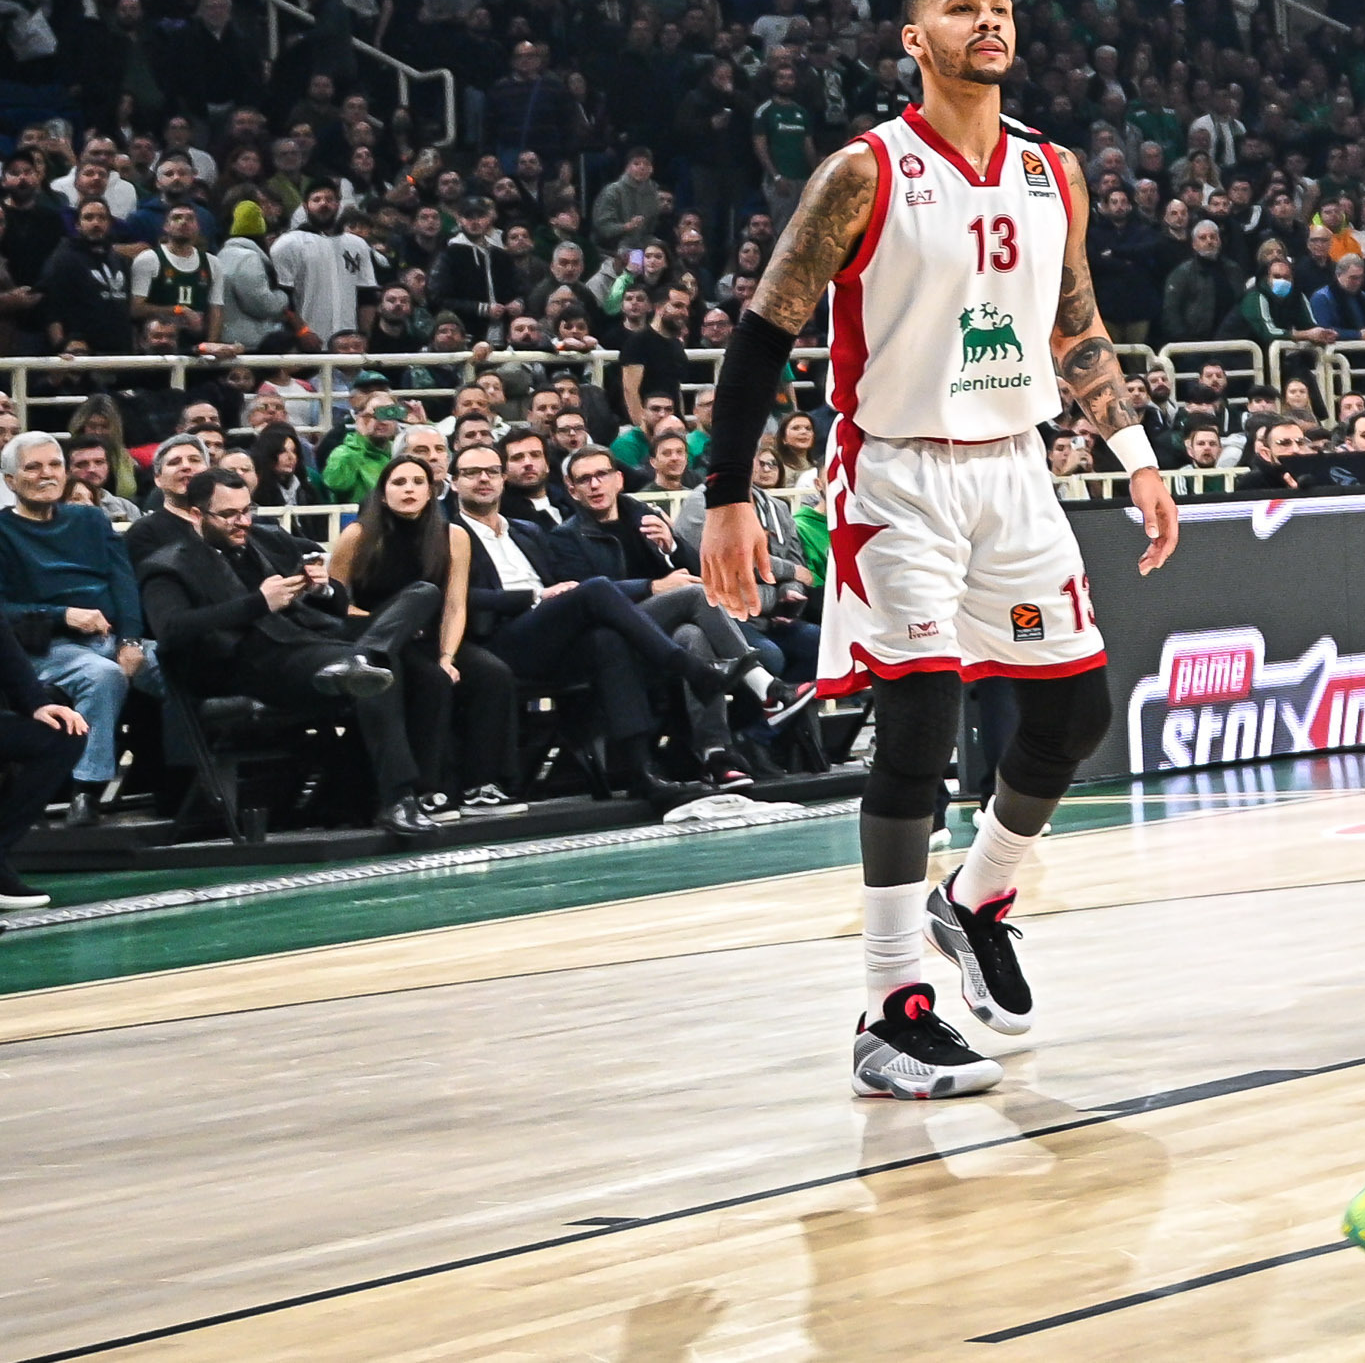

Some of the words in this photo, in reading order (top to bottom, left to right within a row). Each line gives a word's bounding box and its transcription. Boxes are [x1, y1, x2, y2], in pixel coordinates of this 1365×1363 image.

[905, 189, 932, 203] EA7
[967, 213, 1019, 275] 13
[950, 372, 1032, 397] plenitude
[1176, 651, 1248, 704] pame
